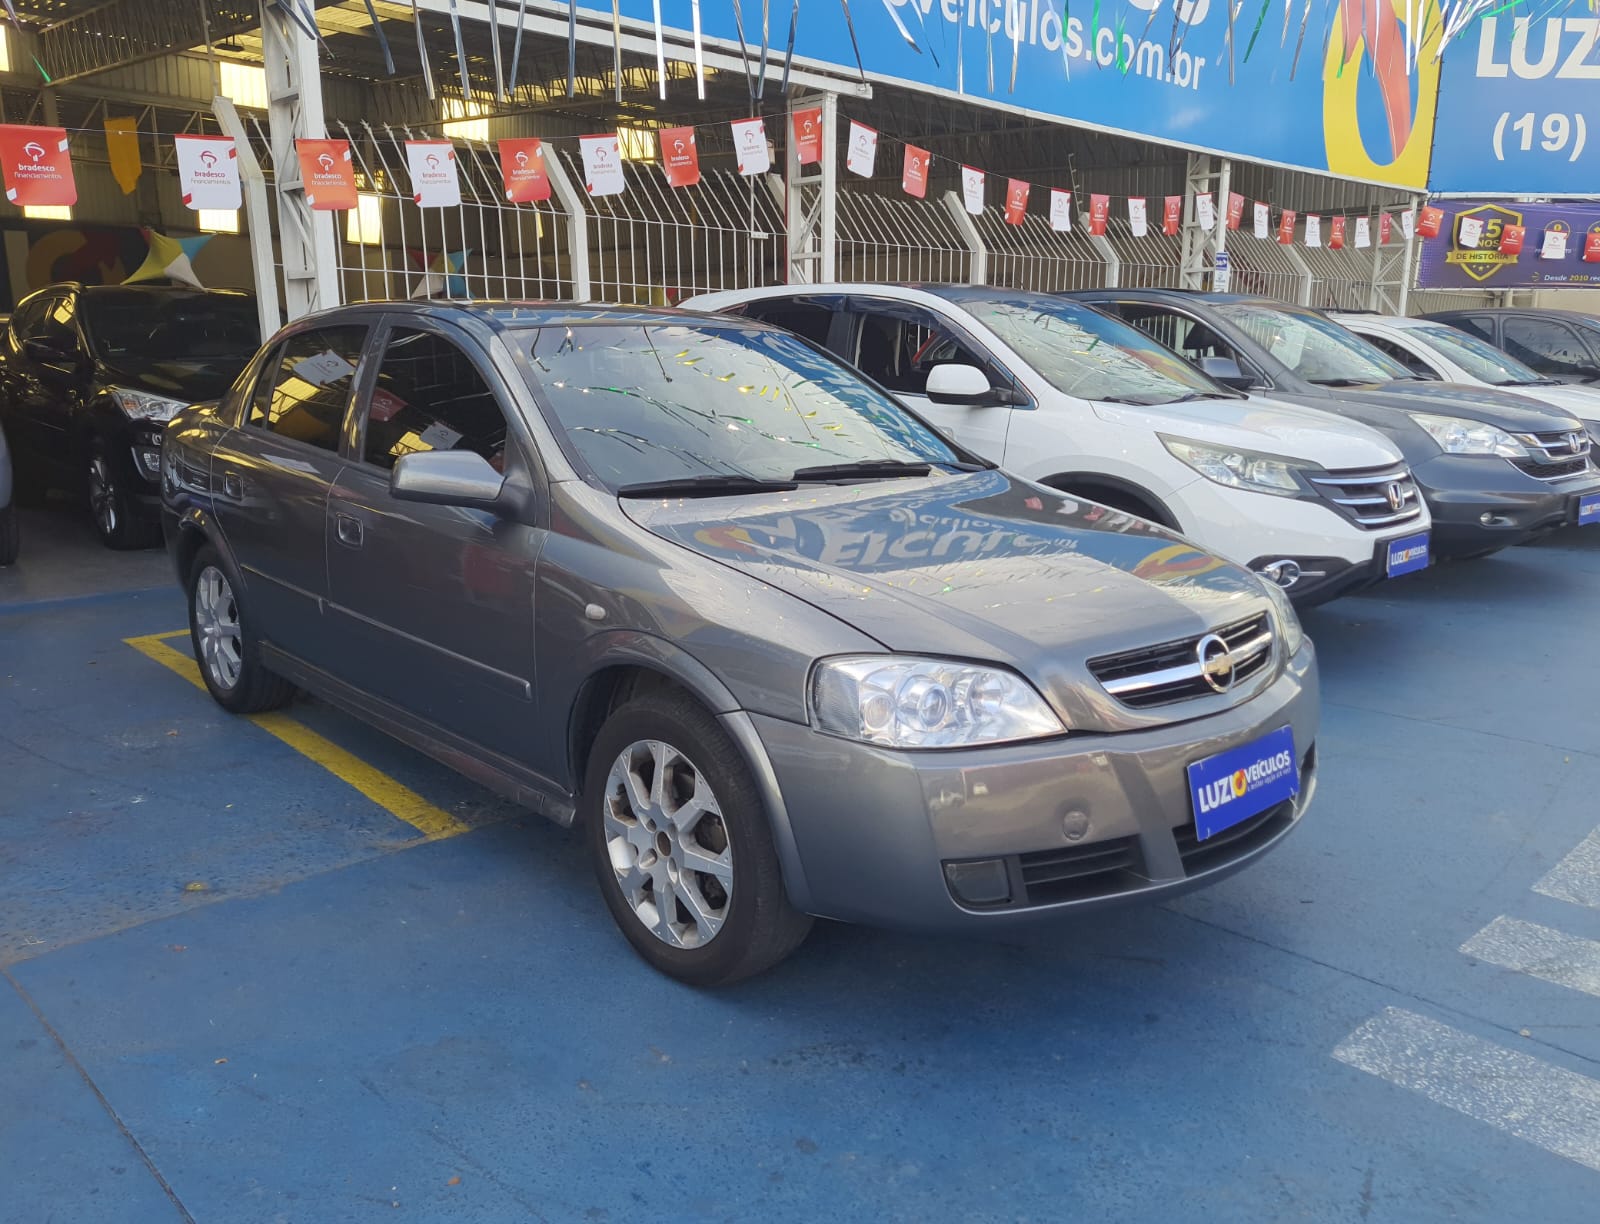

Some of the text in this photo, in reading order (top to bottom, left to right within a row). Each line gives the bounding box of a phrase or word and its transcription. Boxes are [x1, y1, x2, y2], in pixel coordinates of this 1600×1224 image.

[1493, 112, 1587, 161] (19)
[18, 163, 55, 171] bradesco
[14, 171, 63, 179] financiamentos
[194, 170, 226, 178] bradesco
